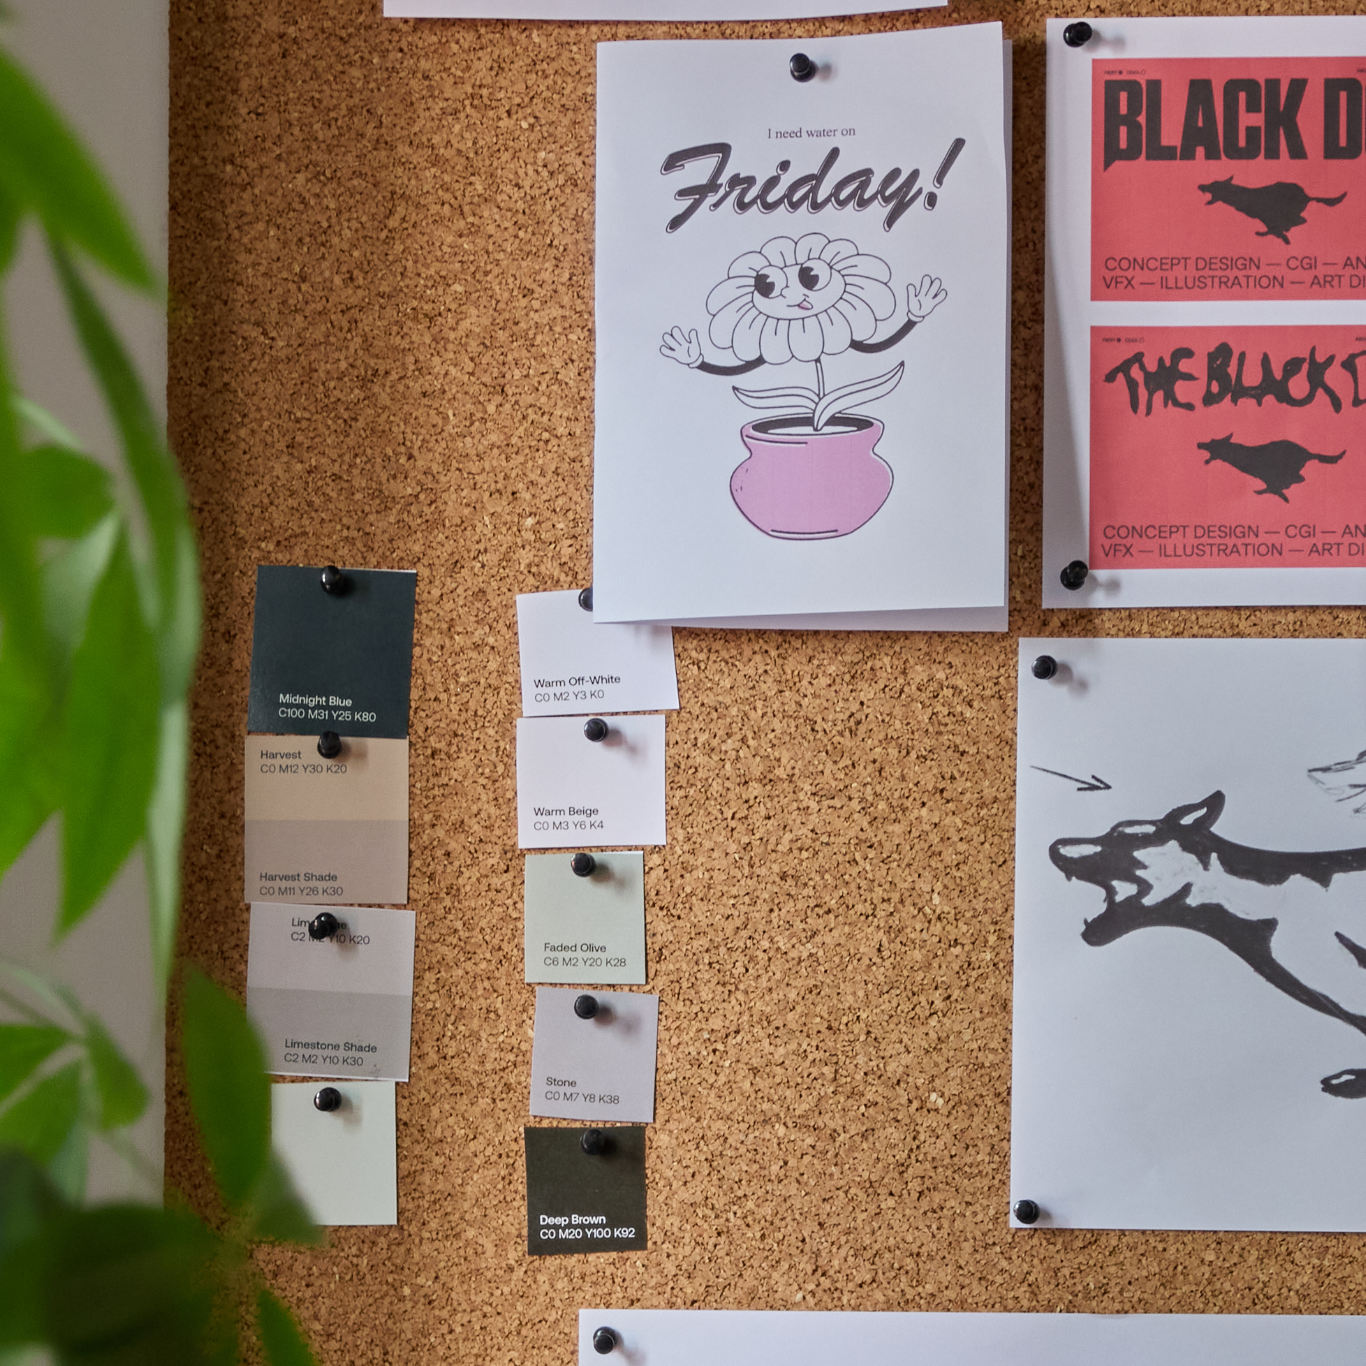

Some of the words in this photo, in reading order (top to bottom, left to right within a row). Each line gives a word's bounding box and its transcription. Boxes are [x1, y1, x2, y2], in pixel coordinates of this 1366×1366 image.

[1104, 78, 1308, 173] BLACK
[776, 127, 802, 138] need
[806, 129, 837, 137] water
[841, 128, 855, 136] on
[660, 138, 966, 233] Friday!
[1104, 257, 1191, 271] CONCEPT
[1196, 257, 1260, 271] DESIGN
[1286, 256, 1317, 270] CGI
[1103, 276, 1135, 289] VFX
[1161, 275, 1284, 289] ILLUSTRATION
[1310, 275, 1345, 288] ART
[1104, 347, 1200, 417] THE
[1203, 342, 1342, 414] BLACK
[1103, 525, 1189, 539] CONCEPT
[1194, 525, 1259, 539] DESIGN
[1285, 524, 1315, 538] CGI
[1101, 544, 1133, 557] VFX
[1159, 543, 1282, 557] ILLUSTRATION
[1308, 543, 1343, 556] ART
[534, 680, 565, 688] Warm
[569, 676, 620, 686] Off-White
[280, 694, 326, 707] Midnight
[329, 696, 352, 706] Blue
[554, 692, 569, 701] M2
[573, 691, 586, 700] Y3
[590, 690, 604, 699] K0
[279, 708, 305, 718] C100
[308, 709, 328, 719] M31
[332, 711, 351, 721] Y25
[355, 712, 376, 722] K80
[261, 750, 301, 759] Harvest
[279, 764, 298, 773] M12
[302, 764, 323, 773] Y30
[326, 764, 348, 774] K20
[534, 808, 565, 816] Warm
[569, 807, 598, 817] Beige
[553, 821, 569, 830] M3
[573, 821, 586, 829] Y6
[590, 821, 603, 829] K4
[260, 872, 300, 881] Harvest
[304, 872, 337, 881] Shade
[278, 887, 295, 895] M11
[299, 886, 319, 896] Y26
[322, 887, 343, 896] K30
[291, 932, 305, 941] C2
[349, 935, 371, 945] K20
[545, 943, 577, 952] Faded
[581, 943, 606, 952] Olive
[544, 957, 559, 966] C6
[563, 957, 578, 966] M2
[582, 957, 602, 966] Y20
[606, 958, 626, 967] K28
[285, 1039, 340, 1050] Limestone
[344, 1042, 377, 1053] Shade
[284, 1053, 298, 1062] C2
[302, 1054, 318, 1063] M2
[321, 1055, 339, 1065] Y10
[343, 1056, 363, 1066] K30
[546, 1077, 576, 1087] Stone
[564, 1092, 579, 1101] M7
[582, 1094, 595, 1102] Y8
[599, 1095, 619, 1104] K38
[540, 1215, 569, 1227] Deep
[572, 1215, 606, 1224] Brown
[559, 1229, 582, 1238] M20
[585, 1228, 611, 1238] Y100
[614, 1228, 635, 1237] K92
